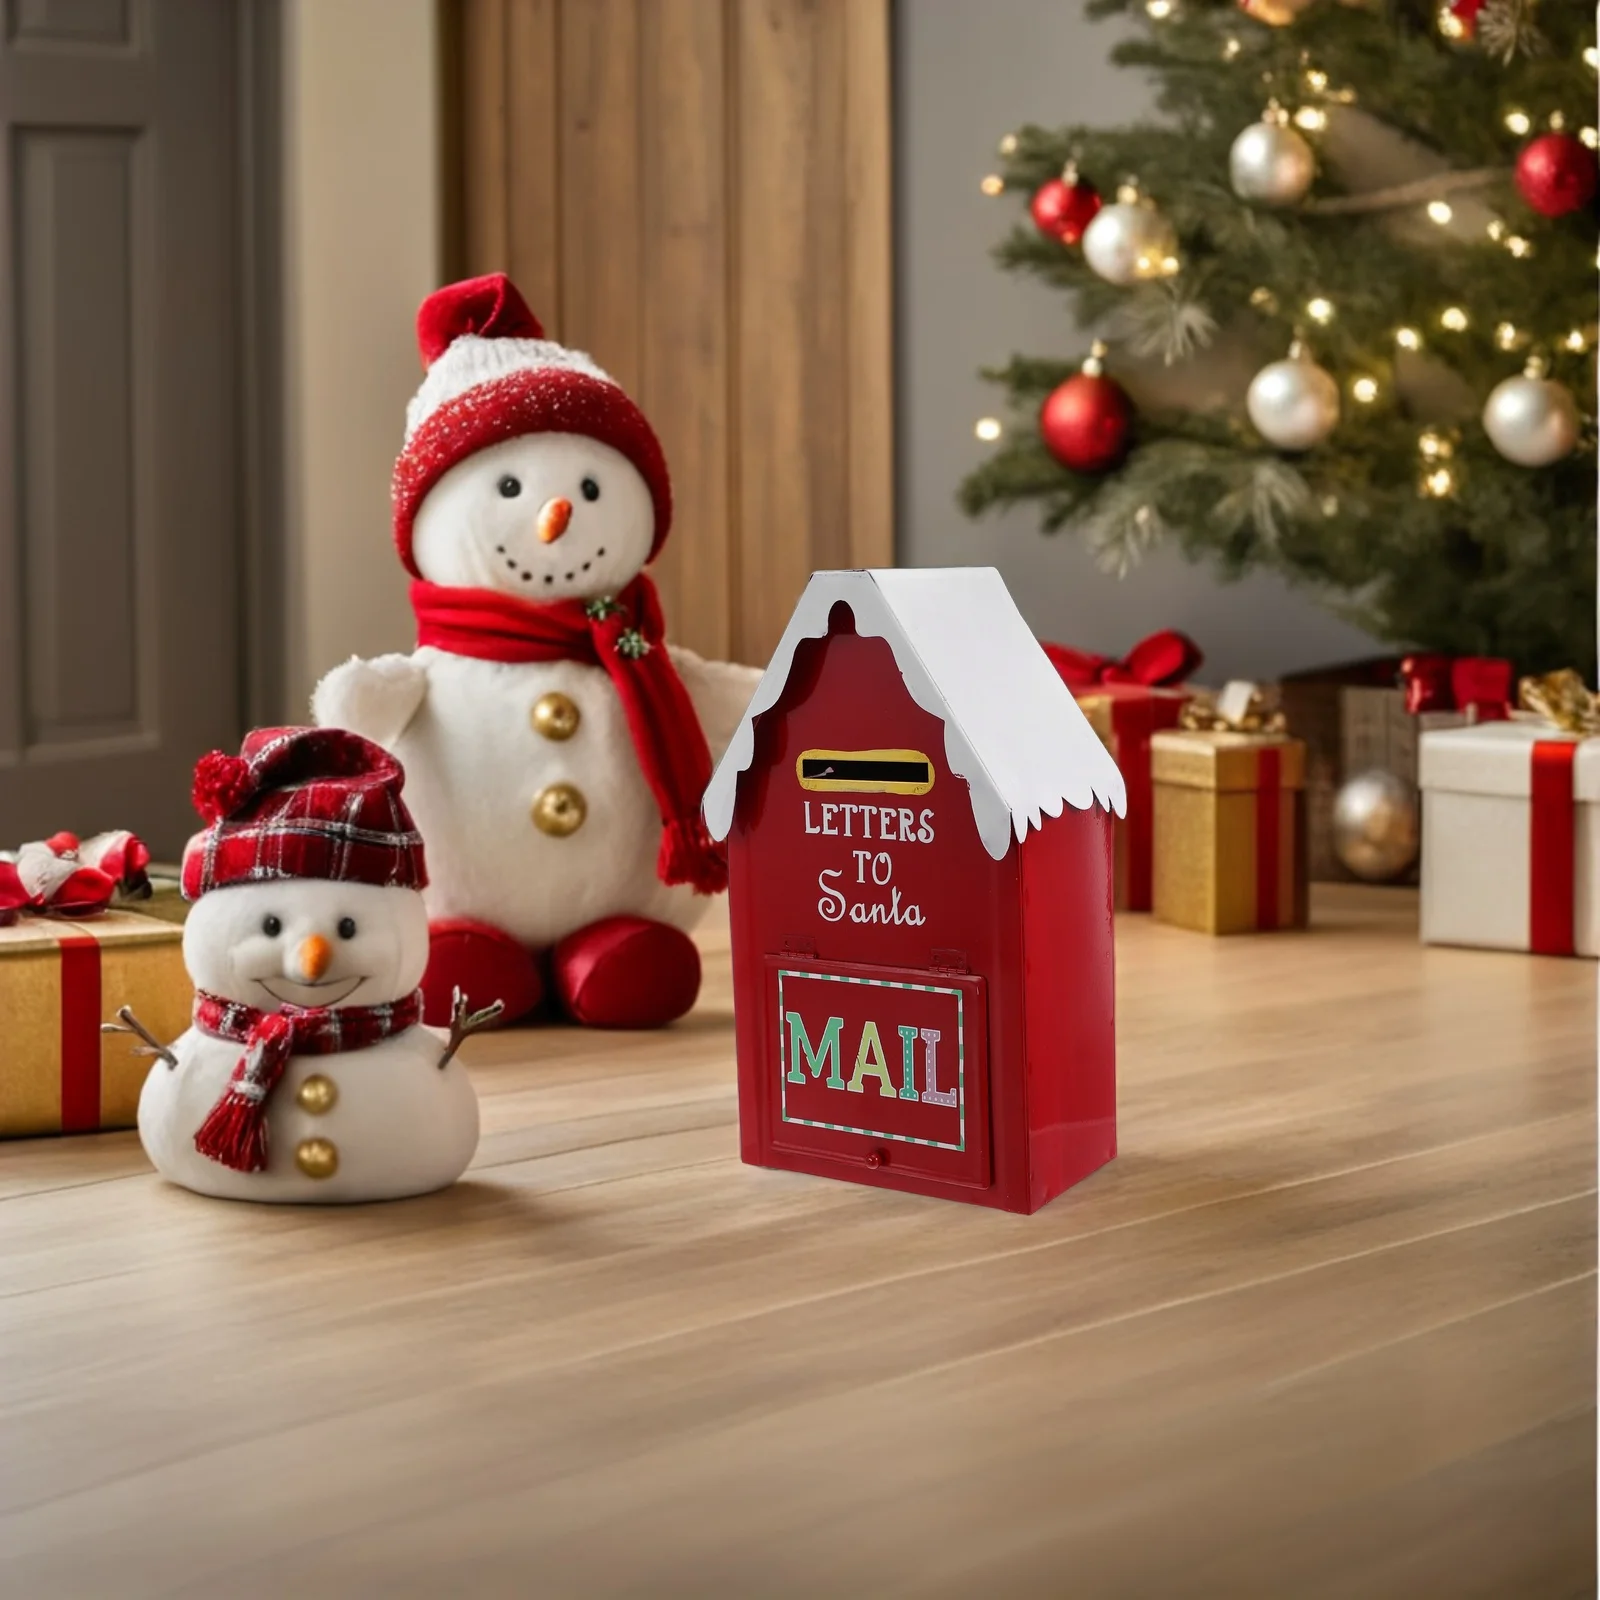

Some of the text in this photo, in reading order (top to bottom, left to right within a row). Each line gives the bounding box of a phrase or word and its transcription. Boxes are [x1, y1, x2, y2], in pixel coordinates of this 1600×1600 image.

[803, 801, 935, 844] LETTERS
[852, 850, 892, 885] TO
[817, 869, 926, 926] Santa
[786, 1011, 957, 1107] MAIL
